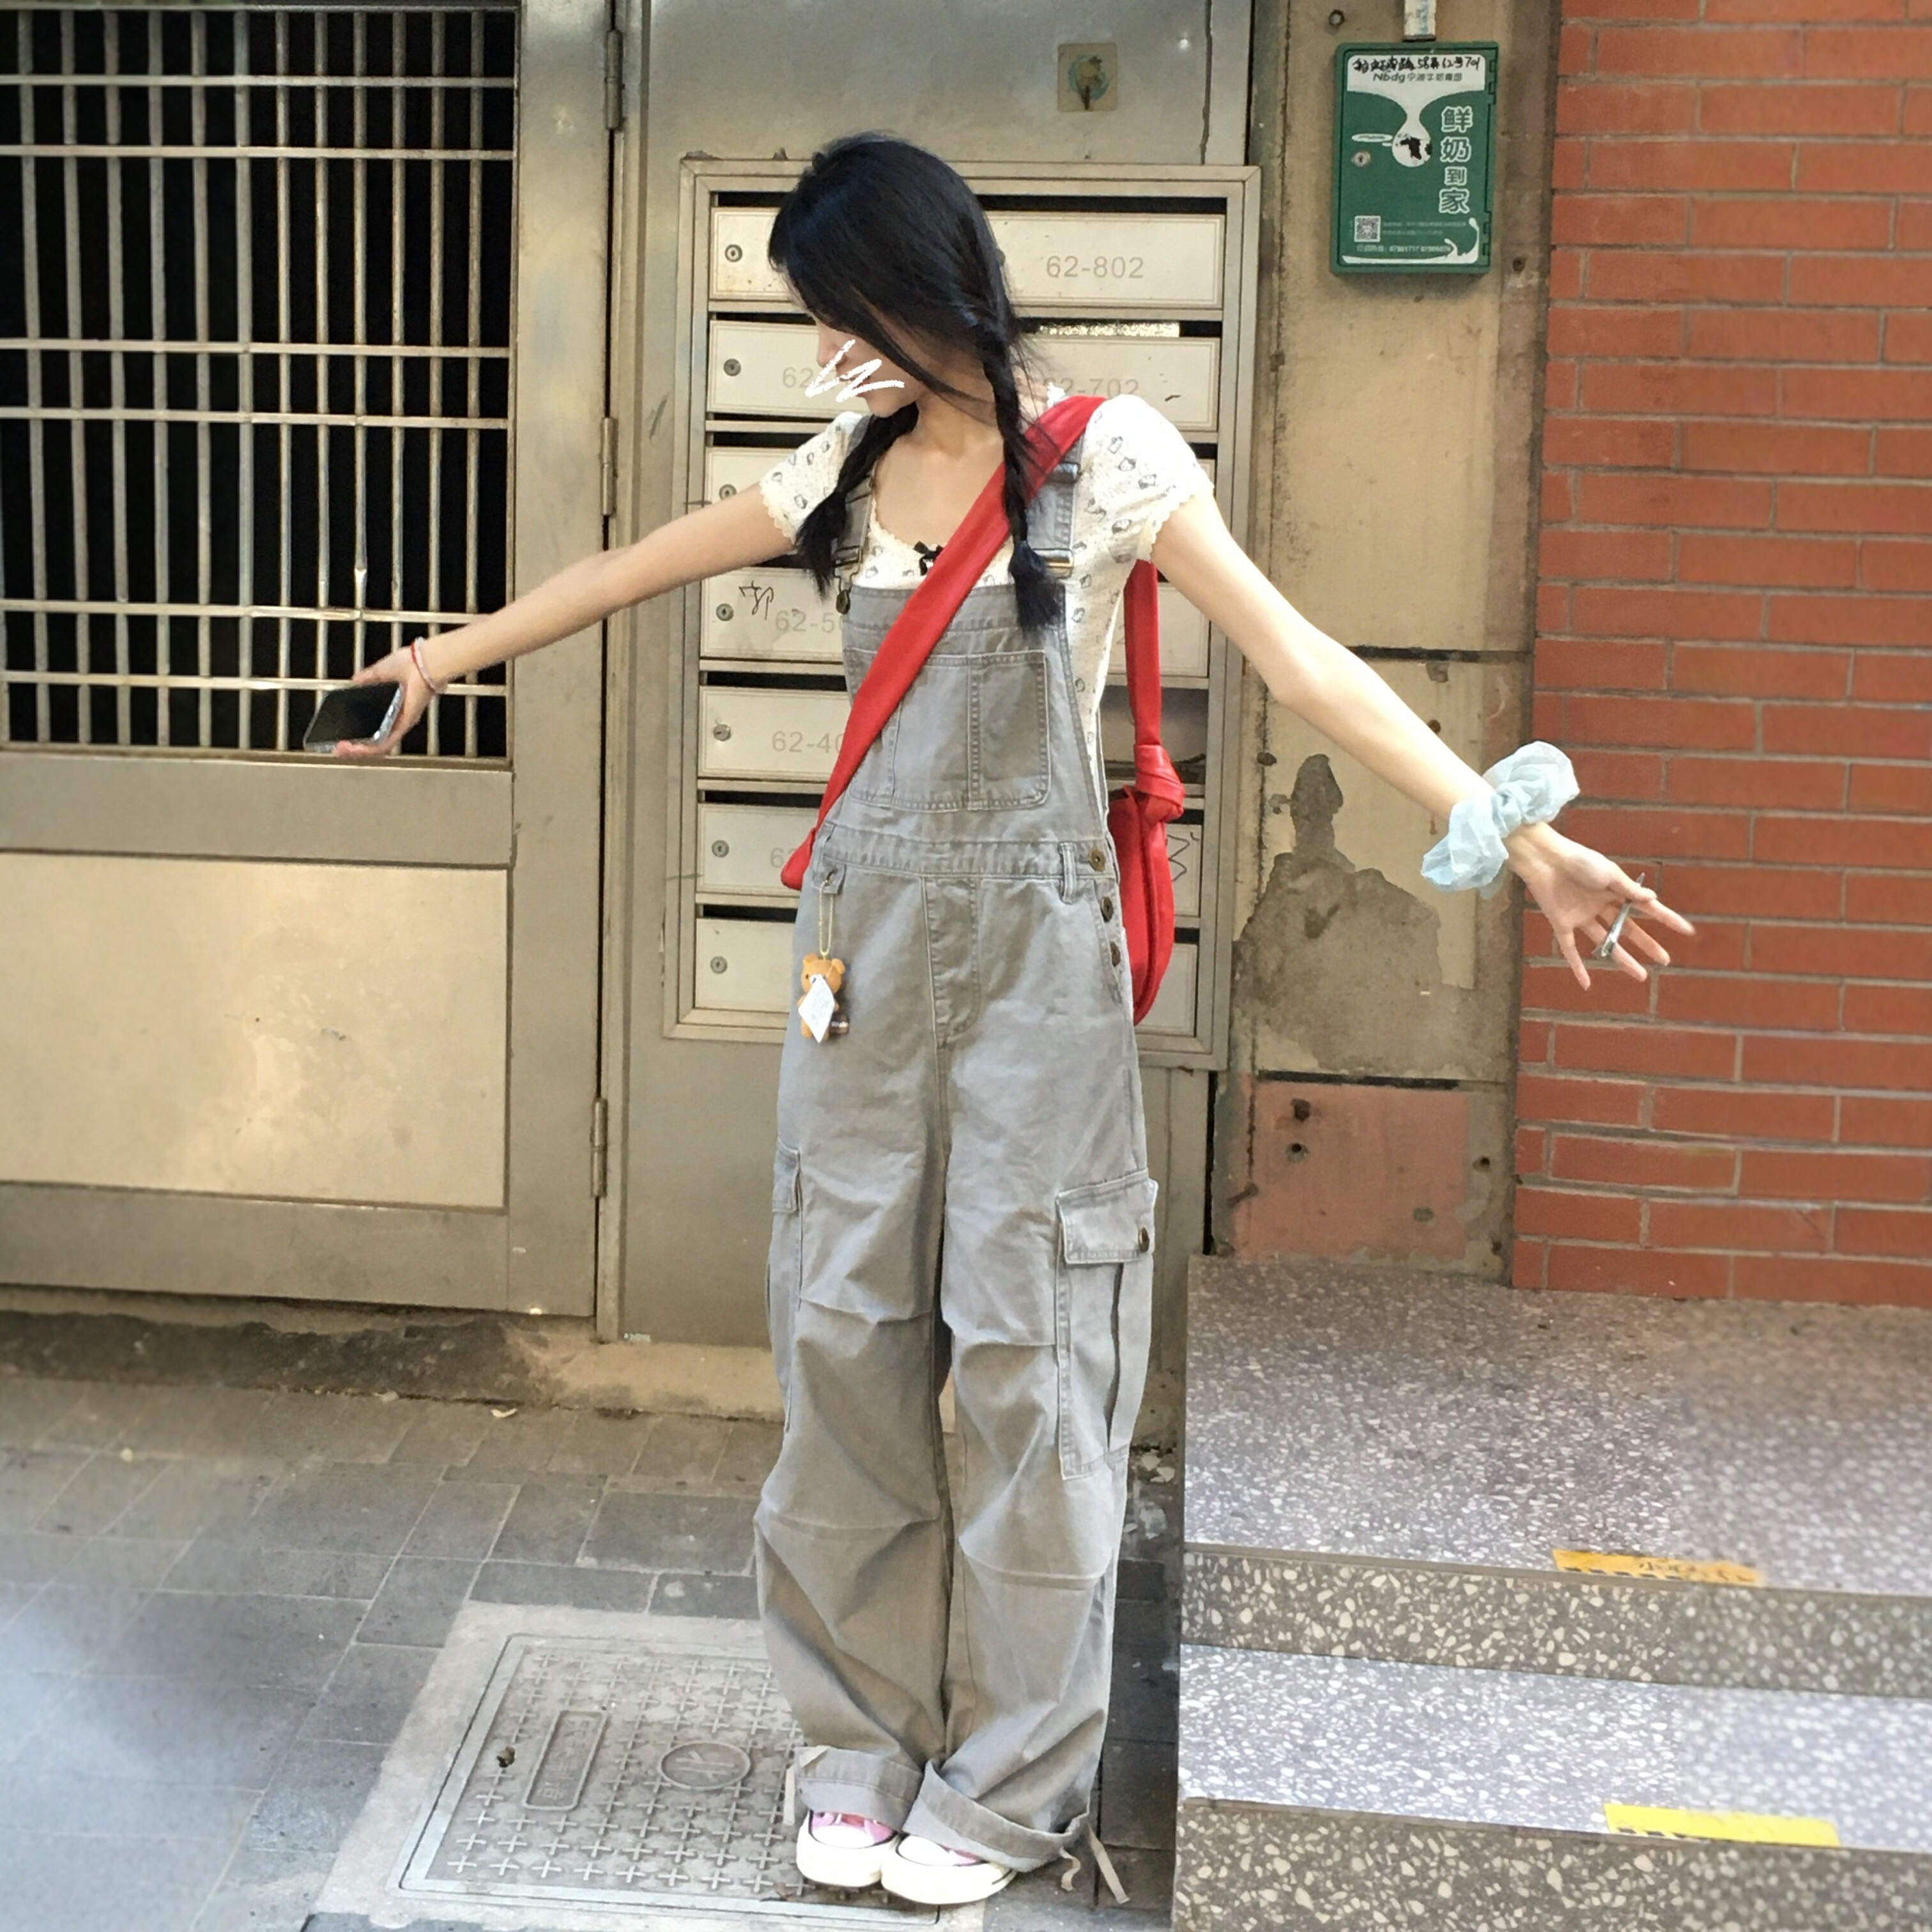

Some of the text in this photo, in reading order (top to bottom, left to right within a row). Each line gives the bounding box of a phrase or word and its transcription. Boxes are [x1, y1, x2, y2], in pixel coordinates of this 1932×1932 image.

[1439, 105, 1473, 215] 鲜奶到家
[1046, 256, 1144, 279] 62-802
[775, 610, 843, 633] 62-5
